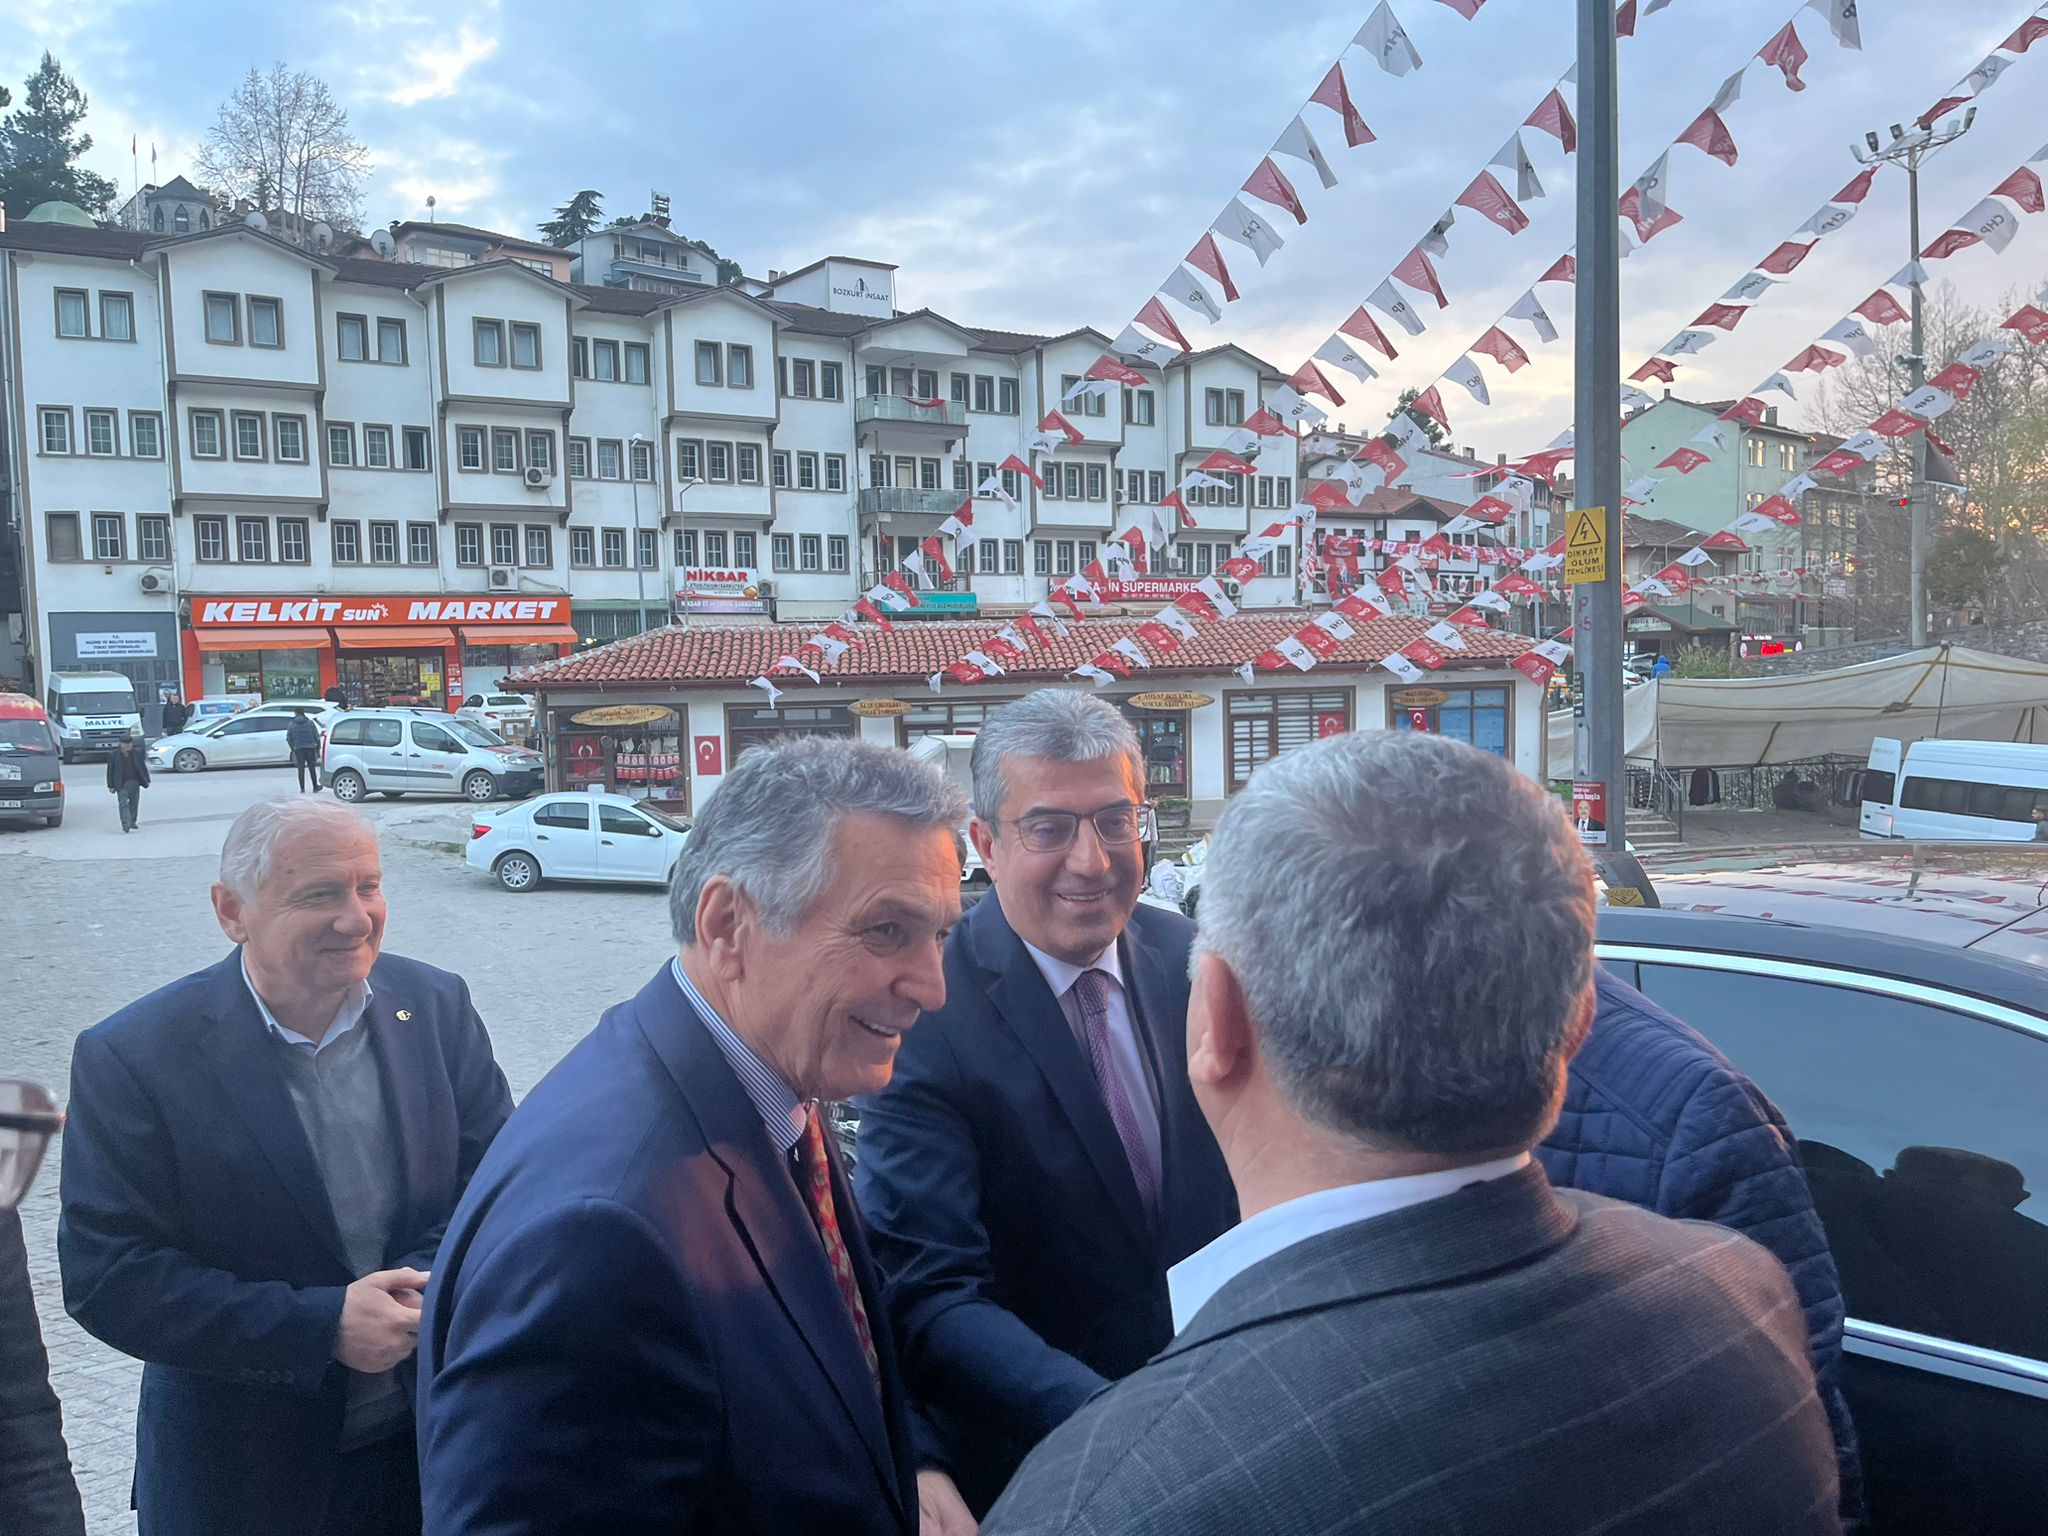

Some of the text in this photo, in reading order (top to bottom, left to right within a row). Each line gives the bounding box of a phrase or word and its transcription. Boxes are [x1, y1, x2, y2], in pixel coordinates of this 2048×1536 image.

[833, 288, 863, 298] BOZKURT
[686, 569, 748, 582] NİKSAR
[1122, 582, 1203, 592] SUPERMARKE
[202, 598, 558, 622] KELKİT SUN MARKET
